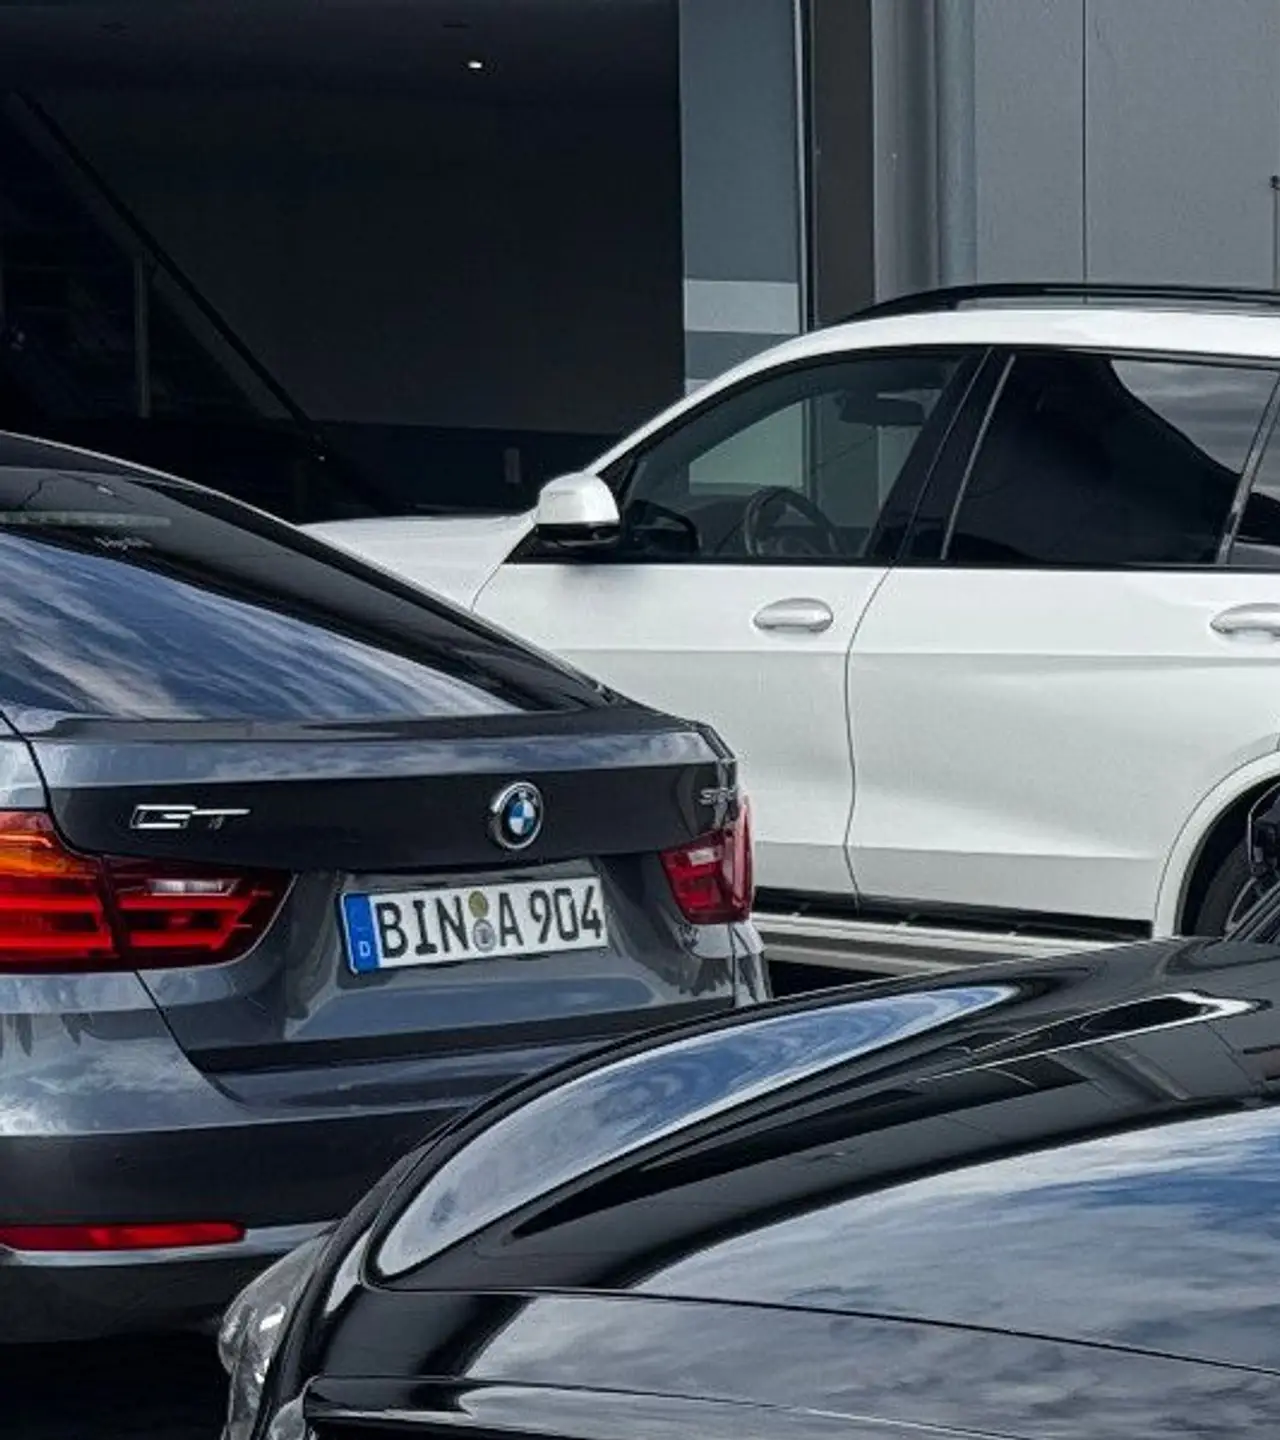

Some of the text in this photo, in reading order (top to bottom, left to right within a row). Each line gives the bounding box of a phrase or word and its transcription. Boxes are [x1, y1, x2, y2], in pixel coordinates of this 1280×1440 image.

[374, 884, 601, 959] BIN A 904
[358, 940, 372, 958] D
